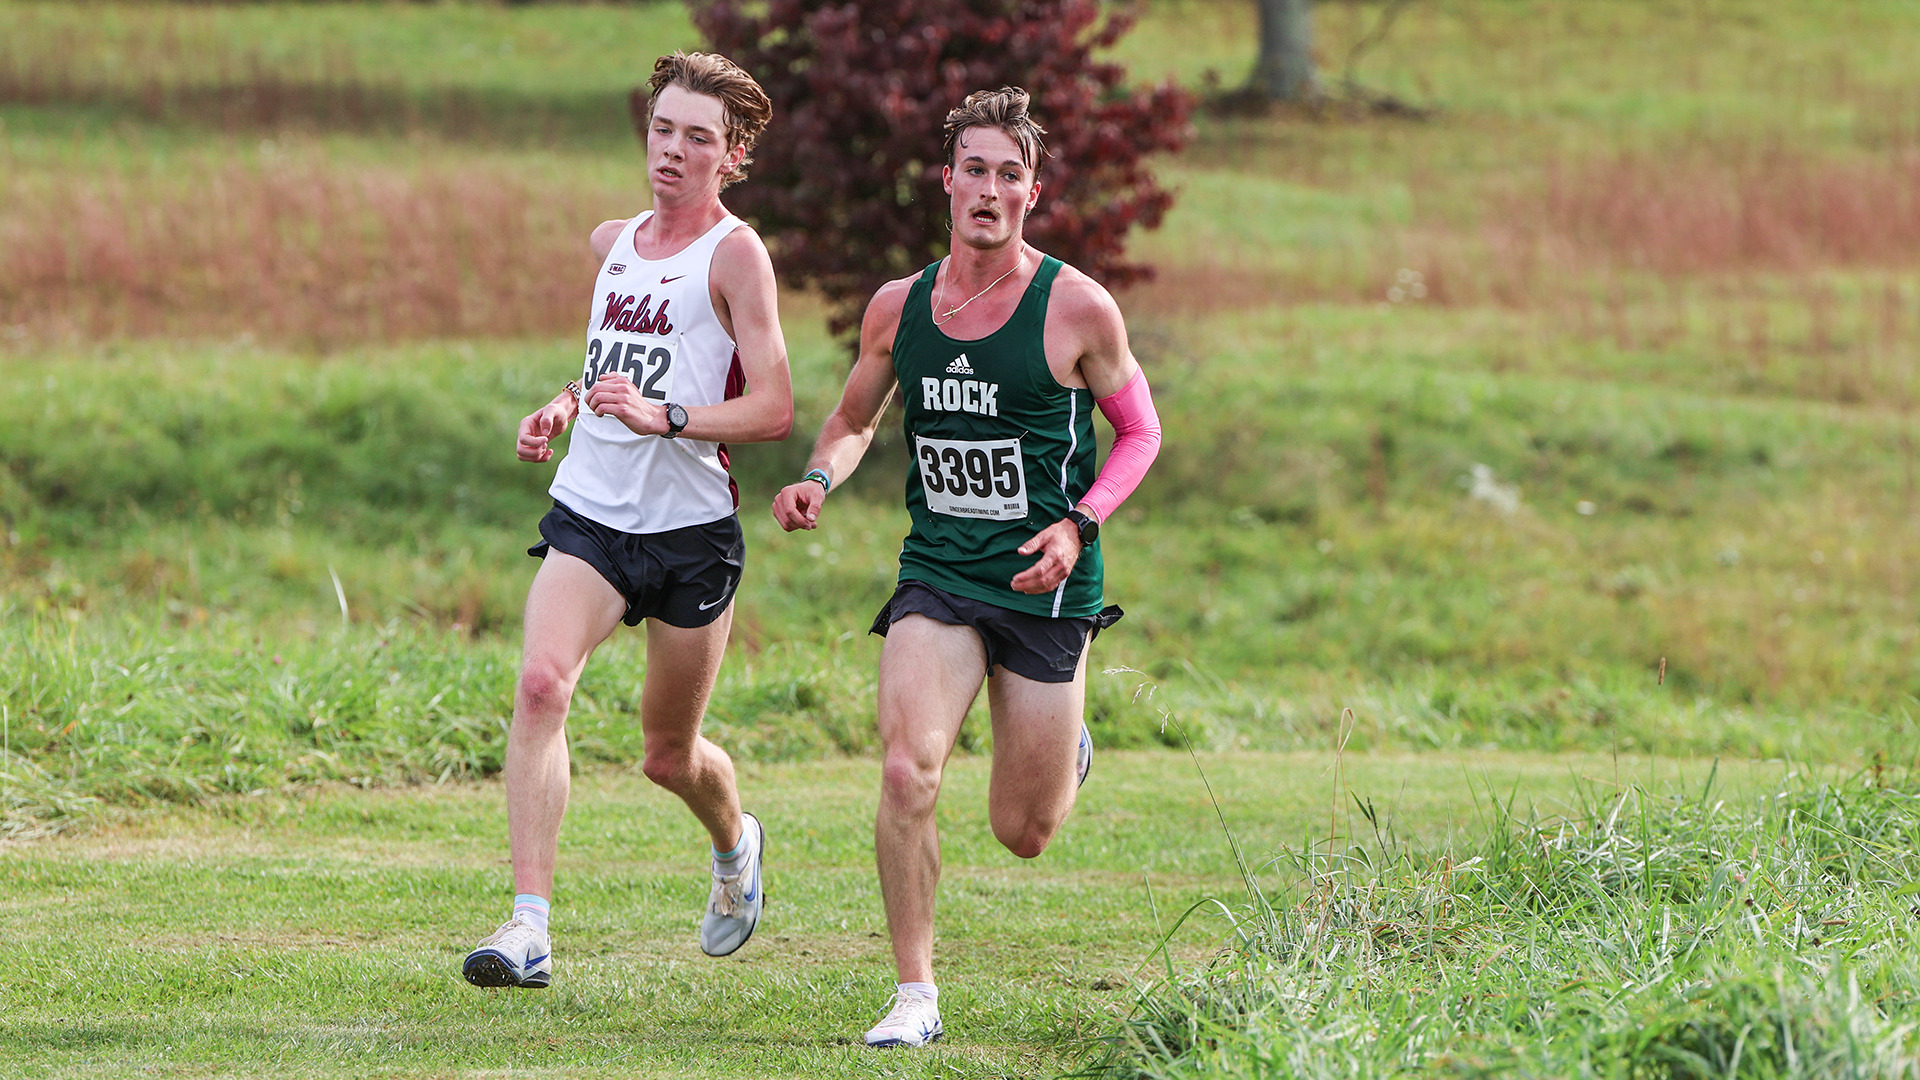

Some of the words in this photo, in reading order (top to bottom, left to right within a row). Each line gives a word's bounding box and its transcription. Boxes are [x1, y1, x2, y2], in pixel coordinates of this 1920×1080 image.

[600, 291, 674, 336] Walsh
[584, 338, 672, 400] 3452
[945, 365, 974, 375] adidas
[921, 376, 999, 417] ROCK
[920, 444, 1021, 499] 3395
